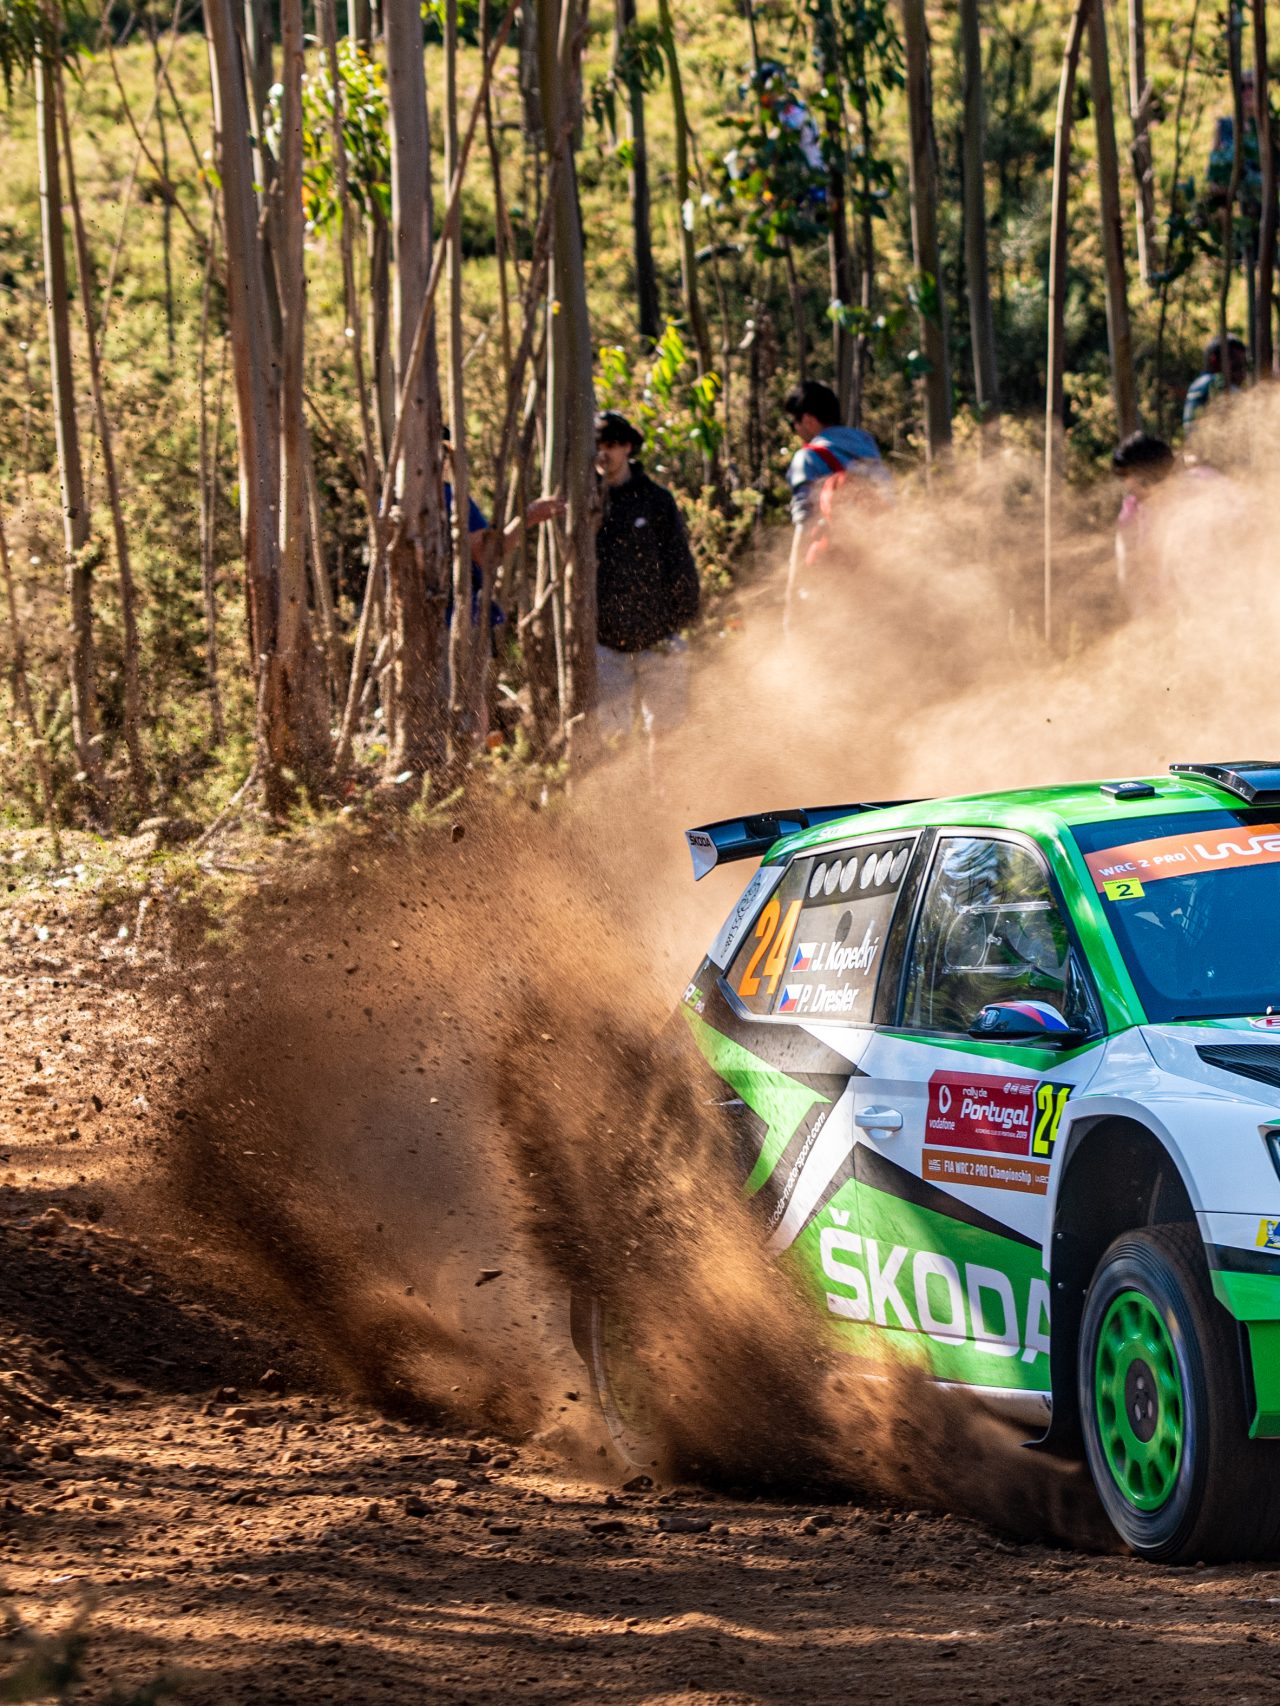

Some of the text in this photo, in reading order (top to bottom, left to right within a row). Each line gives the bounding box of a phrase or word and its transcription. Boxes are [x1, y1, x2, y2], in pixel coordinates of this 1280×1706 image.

[1099, 852, 1186, 877] WRC 2 PRO
[1116, 884, 1134, 897] 2
[738, 899, 803, 997] 24
[811, 937, 880, 977] J. Kopecký
[797, 983, 859, 1013] P. Dresler
[960, 1098, 1029, 1129] Portugal
[944, 1160, 955, 1173] FIA
[955, 1162, 969, 1175] WRC
[969, 1163, 975, 1175] 2
[975, 1164, 988, 1177] PRO
[989, 1165, 1032, 1186] Championship
